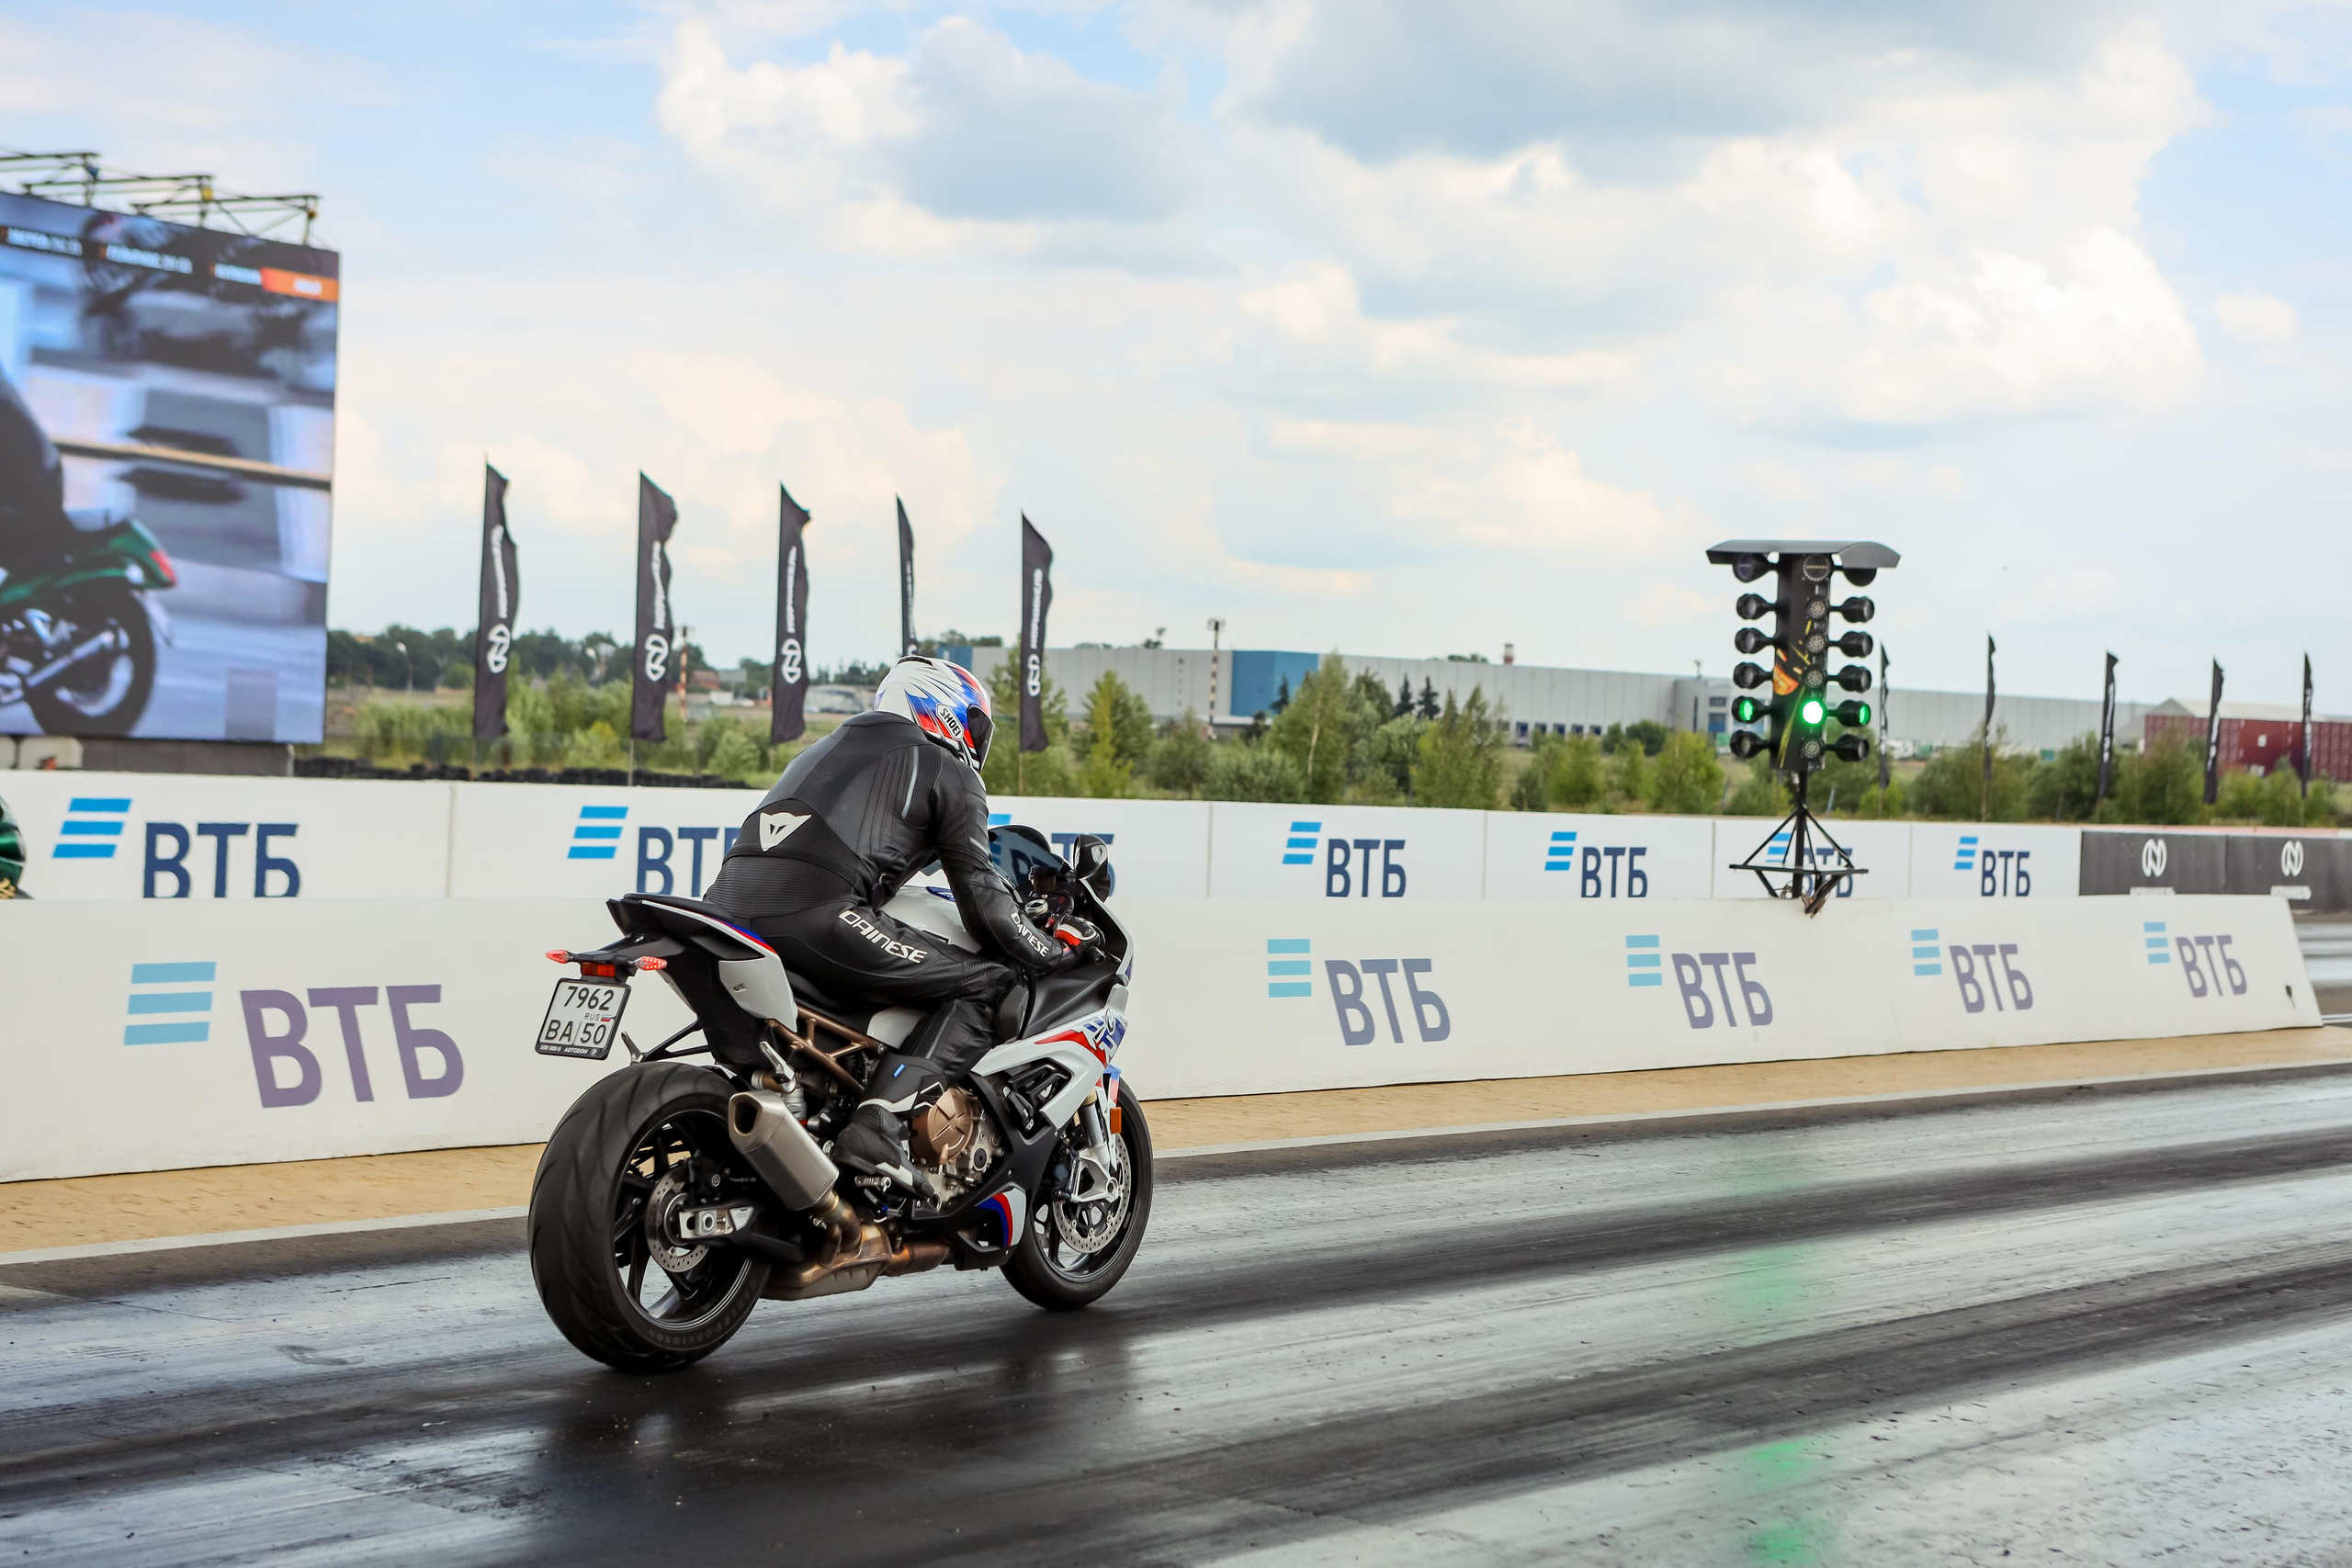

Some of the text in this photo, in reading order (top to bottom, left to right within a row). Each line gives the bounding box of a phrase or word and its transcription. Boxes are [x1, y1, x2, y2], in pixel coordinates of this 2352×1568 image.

[940, 707, 962, 737] SHOEI
[142, 822, 301, 898] ВТБ
[637, 826, 741, 897] ВТ
[1326, 839, 1407, 897] ВТБ
[1581, 846, 1648, 897] ВТБ
[1981, 850, 2031, 897] ВТБ
[838, 909, 928, 964] DAINESE
[1671, 952, 1773, 1030] ВТБ
[1949, 943, 2033, 1014] ВТБ
[2176, 934, 2247, 998] ВТБ
[564, 986, 614, 1010] 7962
[583, 1012, 601, 1021] RUS
[1324, 958, 1451, 1046] ВТБ
[240, 984, 465, 1109] ВТБ
[581, 1022, 606, 1045] 50
